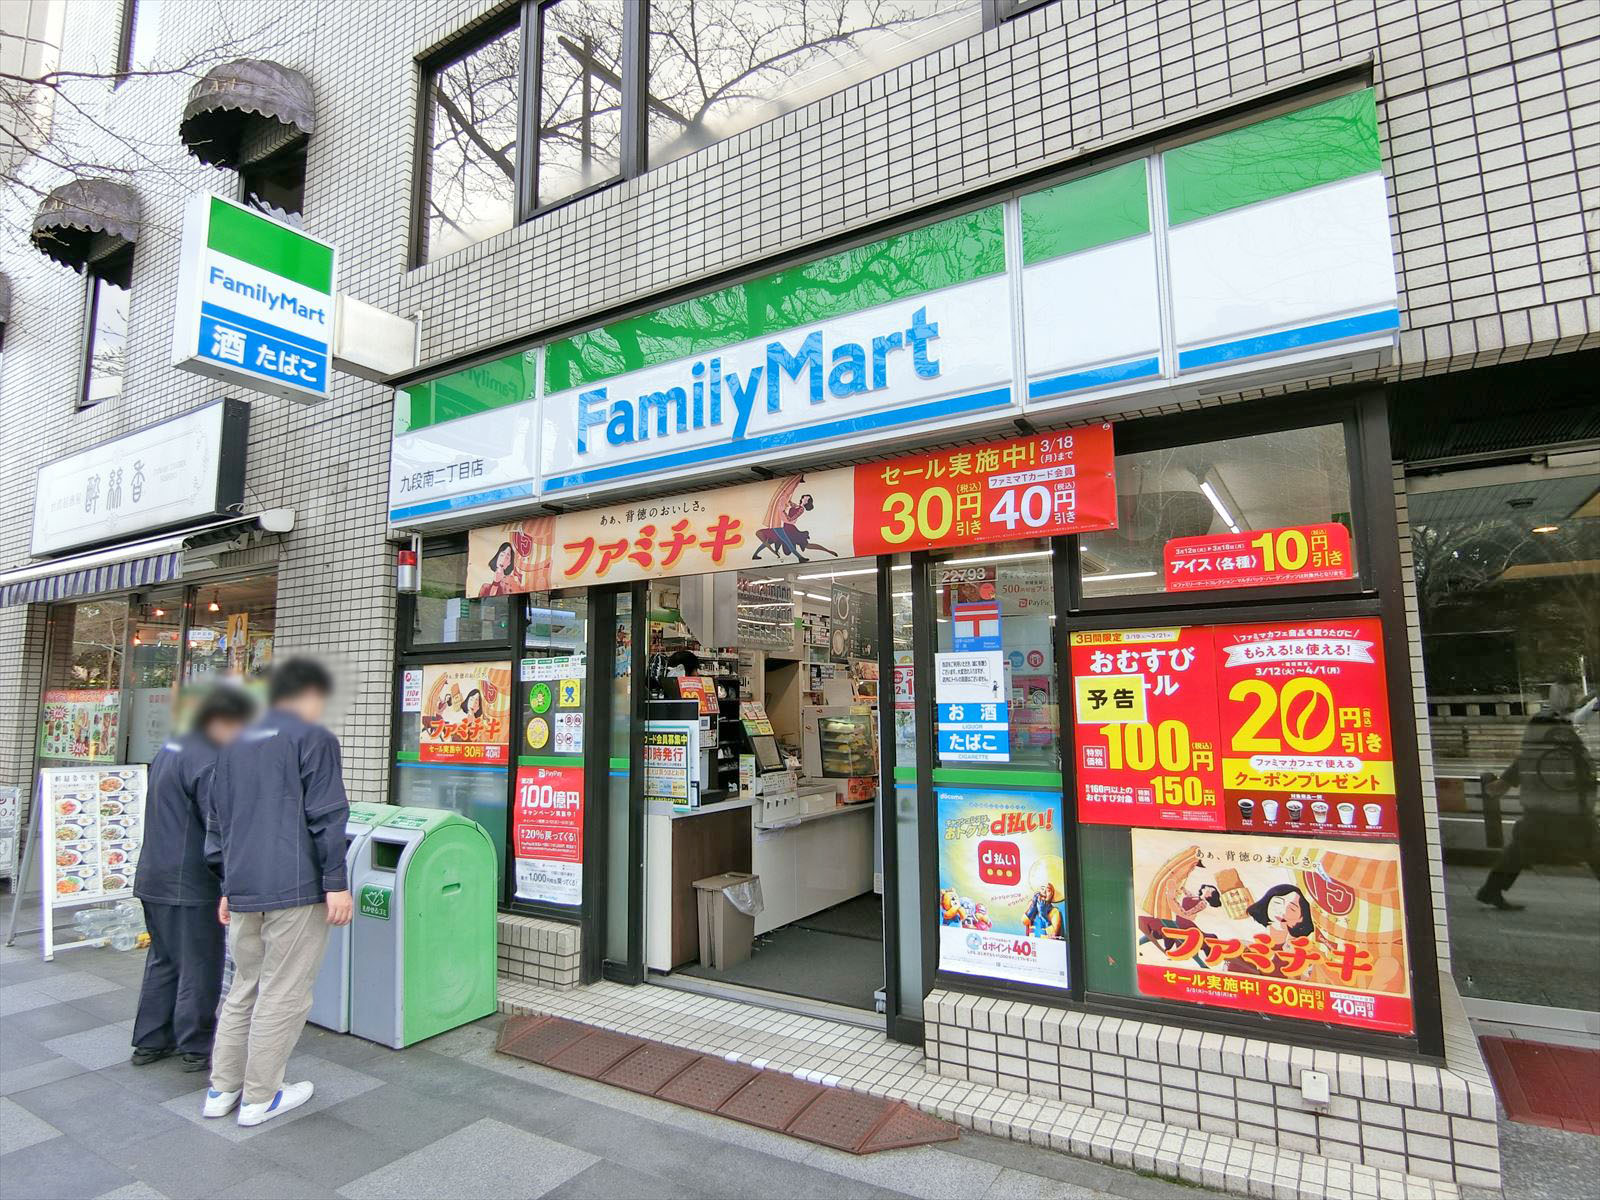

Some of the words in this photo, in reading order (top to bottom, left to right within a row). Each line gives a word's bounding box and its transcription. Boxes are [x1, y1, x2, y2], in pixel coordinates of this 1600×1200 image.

[209, 266, 325, 324] FamilyMart
[211, 324, 248, 365] 酒
[256, 344, 317, 383] たばこ
[577, 305, 941, 455] FamilyMart
[1040, 435, 1074, 452] 3/18
[881, 442, 1035, 487] セール実施中!
[1040, 451, 1074, 465] (月)まで
[400, 458, 484, 494] 九段南二丁目店
[990, 466, 1075, 489] ファミマTカード会員
[600, 501, 707, 527] あぁ、背徳のおいしさ。
[563, 515, 741, 576] ファミチキ
[1251, 529, 1309, 572] 10
[941, 567, 986, 583] 22793
[1076, 633, 1122, 645] 3日間限定
[1089, 646, 1196, 674] おむすび
[1087, 688, 1135, 710] 予告
[431, 717, 501, 740] ファミチキ
[949, 733, 998, 751] たばこ
[1099, 720, 1190, 772] 100
[1256, 758, 1355, 769] ファミマカフェで使える
[1150, 776, 1202, 806] 150
[1235, 771, 1380, 791] クーポンプレゼント
[520, 785, 580, 809] 100億円
[990, 808, 1054, 836] d払い!
[982, 850, 1016, 865] d払い
[1196, 849, 1321, 869] あぁ、背徳のおいしさ。
[1161, 927, 1374, 983] ファミチキ
[1163, 970, 1260, 997] セール実施中!
